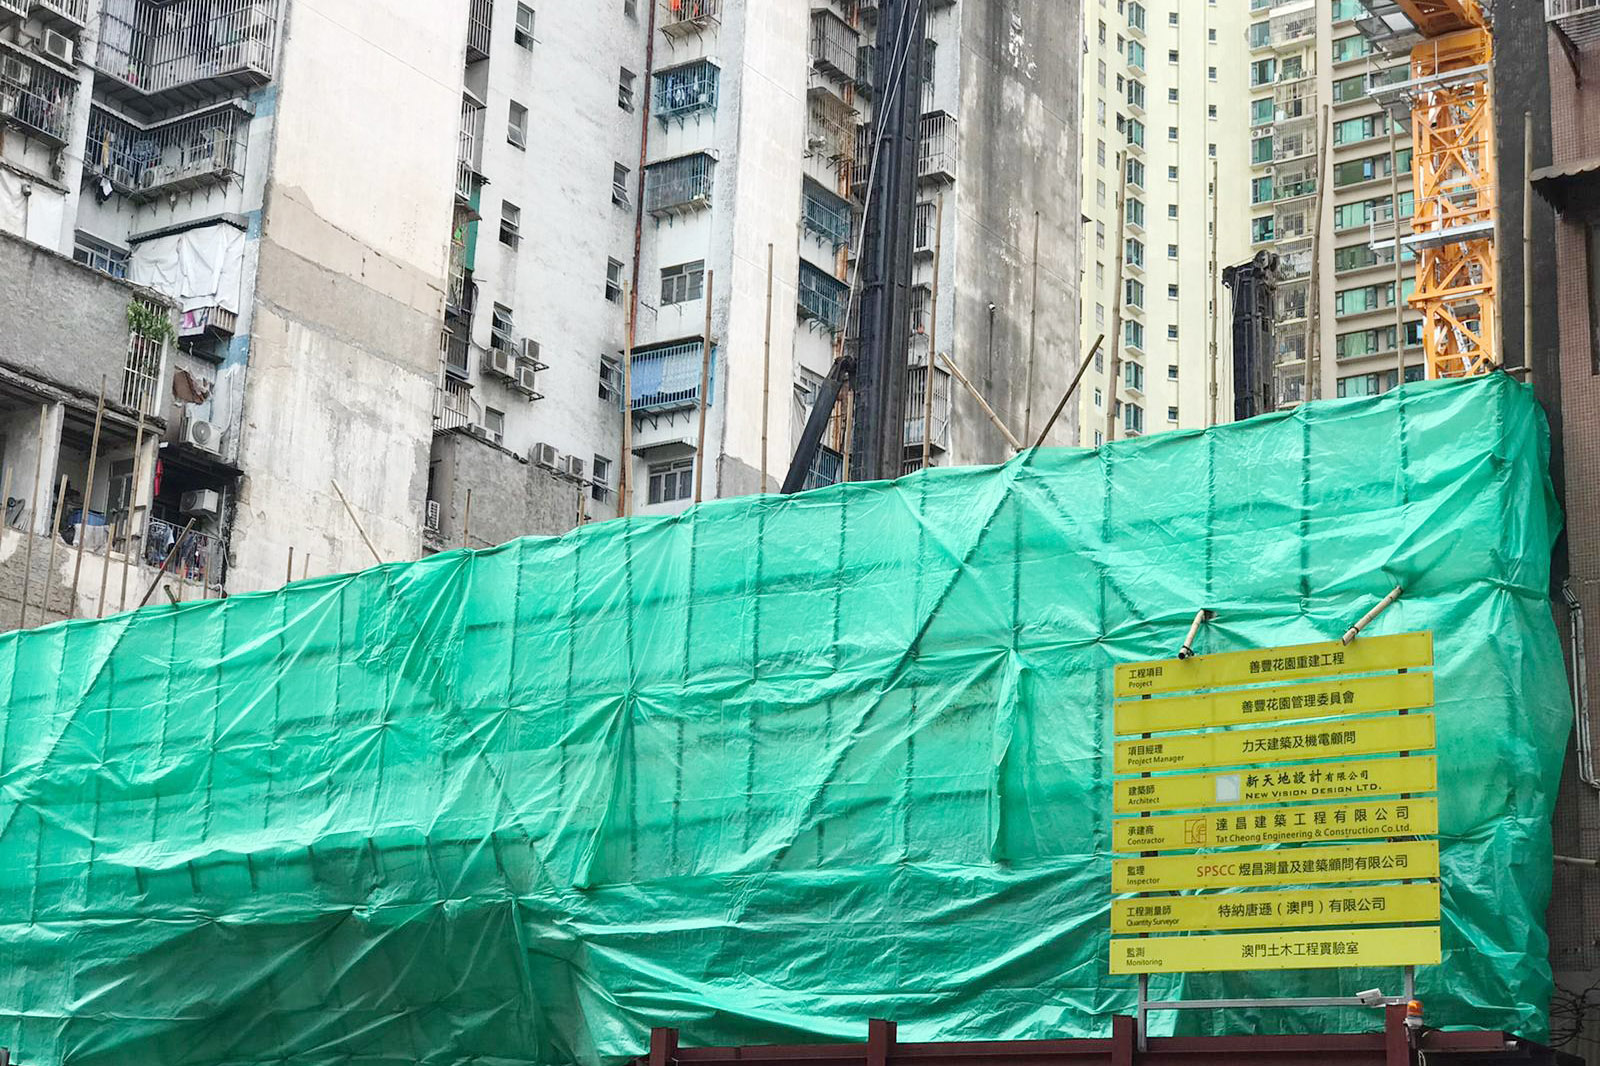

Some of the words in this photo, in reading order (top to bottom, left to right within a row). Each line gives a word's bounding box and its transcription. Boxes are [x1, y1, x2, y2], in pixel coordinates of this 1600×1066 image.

[1249, 651, 1345, 674] 善豐花園重建工程
[1128, 680, 1152, 689] Project
[1241, 690, 1355, 714] 善豐花園管理委員會
[1242, 730, 1356, 753] 力天建築及機電顧問
[1127, 757, 1152, 766] Project
[1153, 755, 1185, 764] Manager
[1246, 768, 1369, 788] 新天地設計有限公司
[1356, 783, 1383, 791] LTD.
[1128, 797, 1160, 805] Architect
[1216, 805, 1409, 831] 達昌建築工程有限公司
[1215, 835, 1228, 843] Tat
[1229, 833, 1261, 842] Cheong
[1262, 829, 1313, 841] Engineering
[1314, 828, 1322, 837] &
[1323, 825, 1380, 837] Construction
[1127, 837, 1165, 846] Contractor
[1196, 863, 1236, 877] SPSCC
[1127, 877, 1160, 887] Inspector
[1126, 919, 1152, 927] Quantity
[1153, 918, 1180, 926] Surveyor
[1241, 941, 1359, 958] 澳門土木工程實驗室
[1126, 958, 1163, 967] Monitoring
